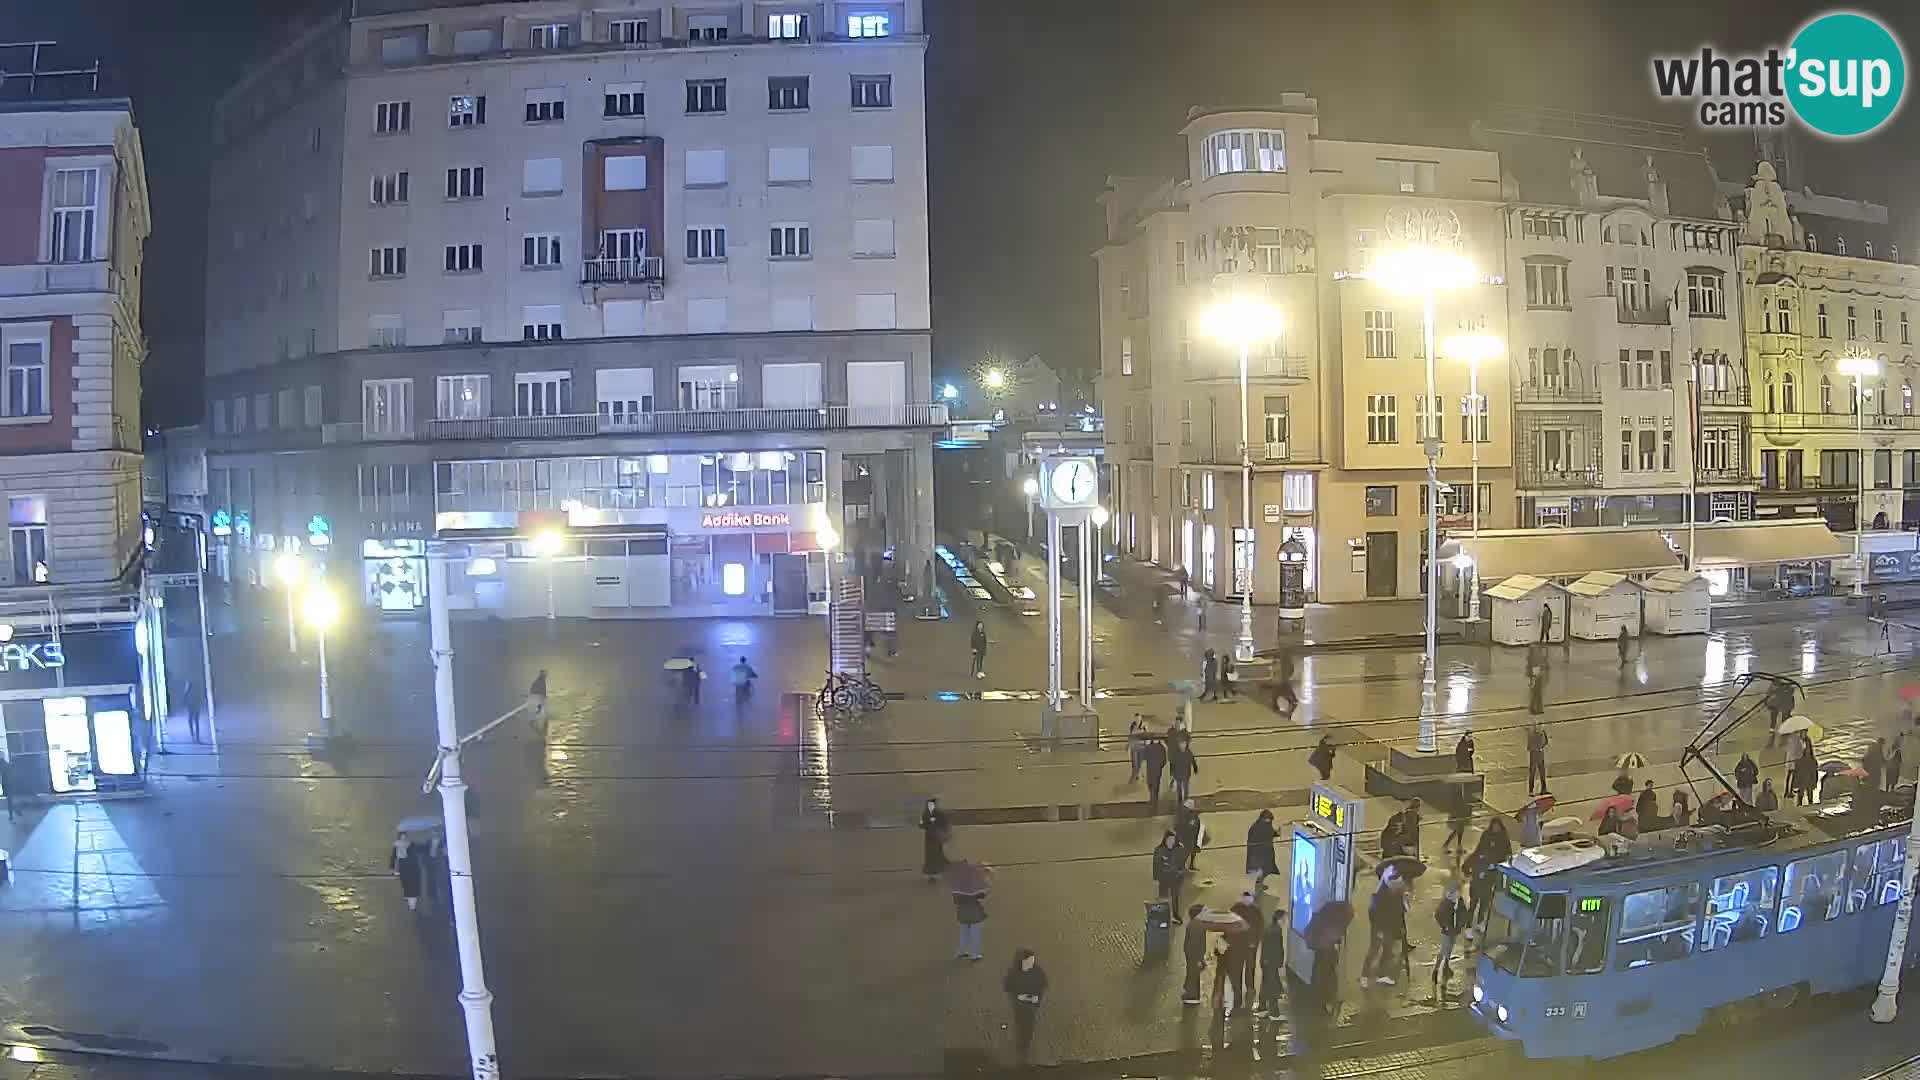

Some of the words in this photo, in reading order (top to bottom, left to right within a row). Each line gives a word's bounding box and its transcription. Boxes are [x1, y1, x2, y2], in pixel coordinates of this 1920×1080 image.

[702, 512, 751, 528] Addiko
[753, 512, 790, 526] Bank
[1545, 1007, 1565, 1017] 333
